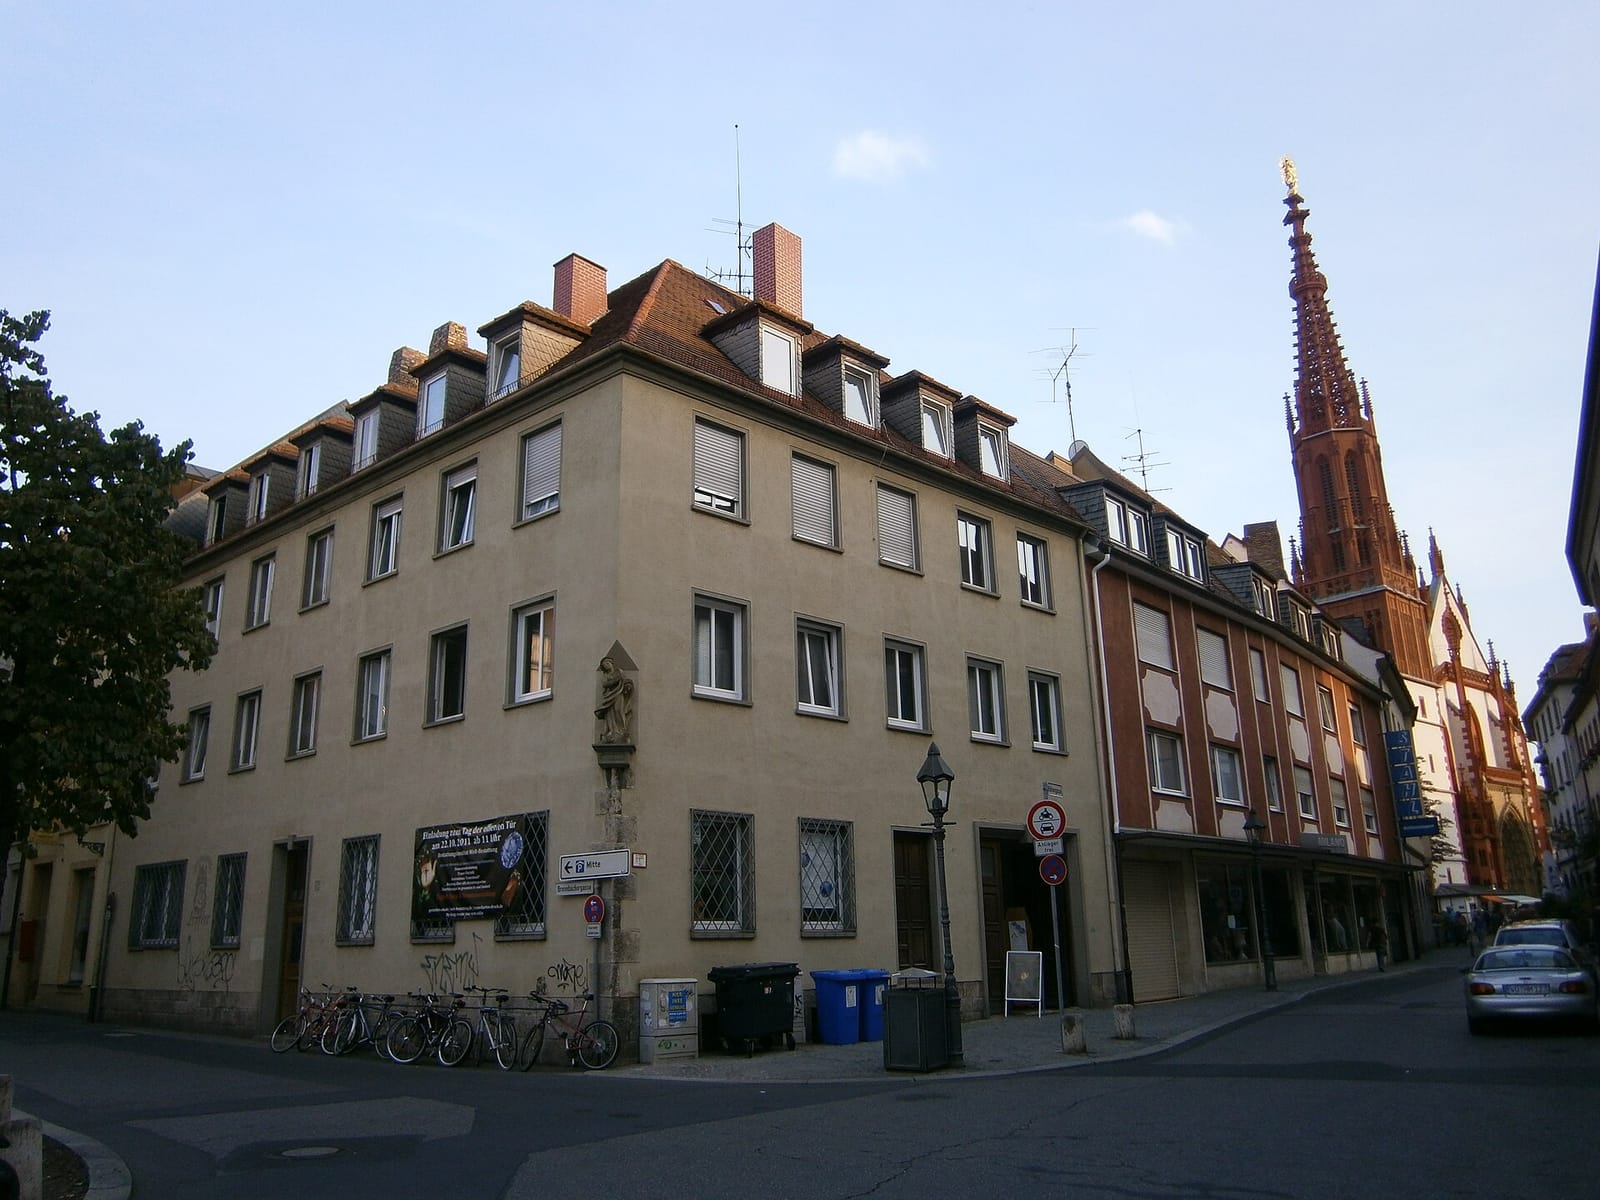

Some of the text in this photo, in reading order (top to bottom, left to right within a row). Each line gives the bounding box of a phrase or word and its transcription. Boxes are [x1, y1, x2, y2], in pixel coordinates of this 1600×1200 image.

[462, 827, 472, 836] Tag
[472, 825, 482, 834] der
[505, 820, 517, 829] Tür
[473, 836, 481, 845] ab
[482, 835, 488, 844] 11
[490, 833, 501, 842] Uhr
